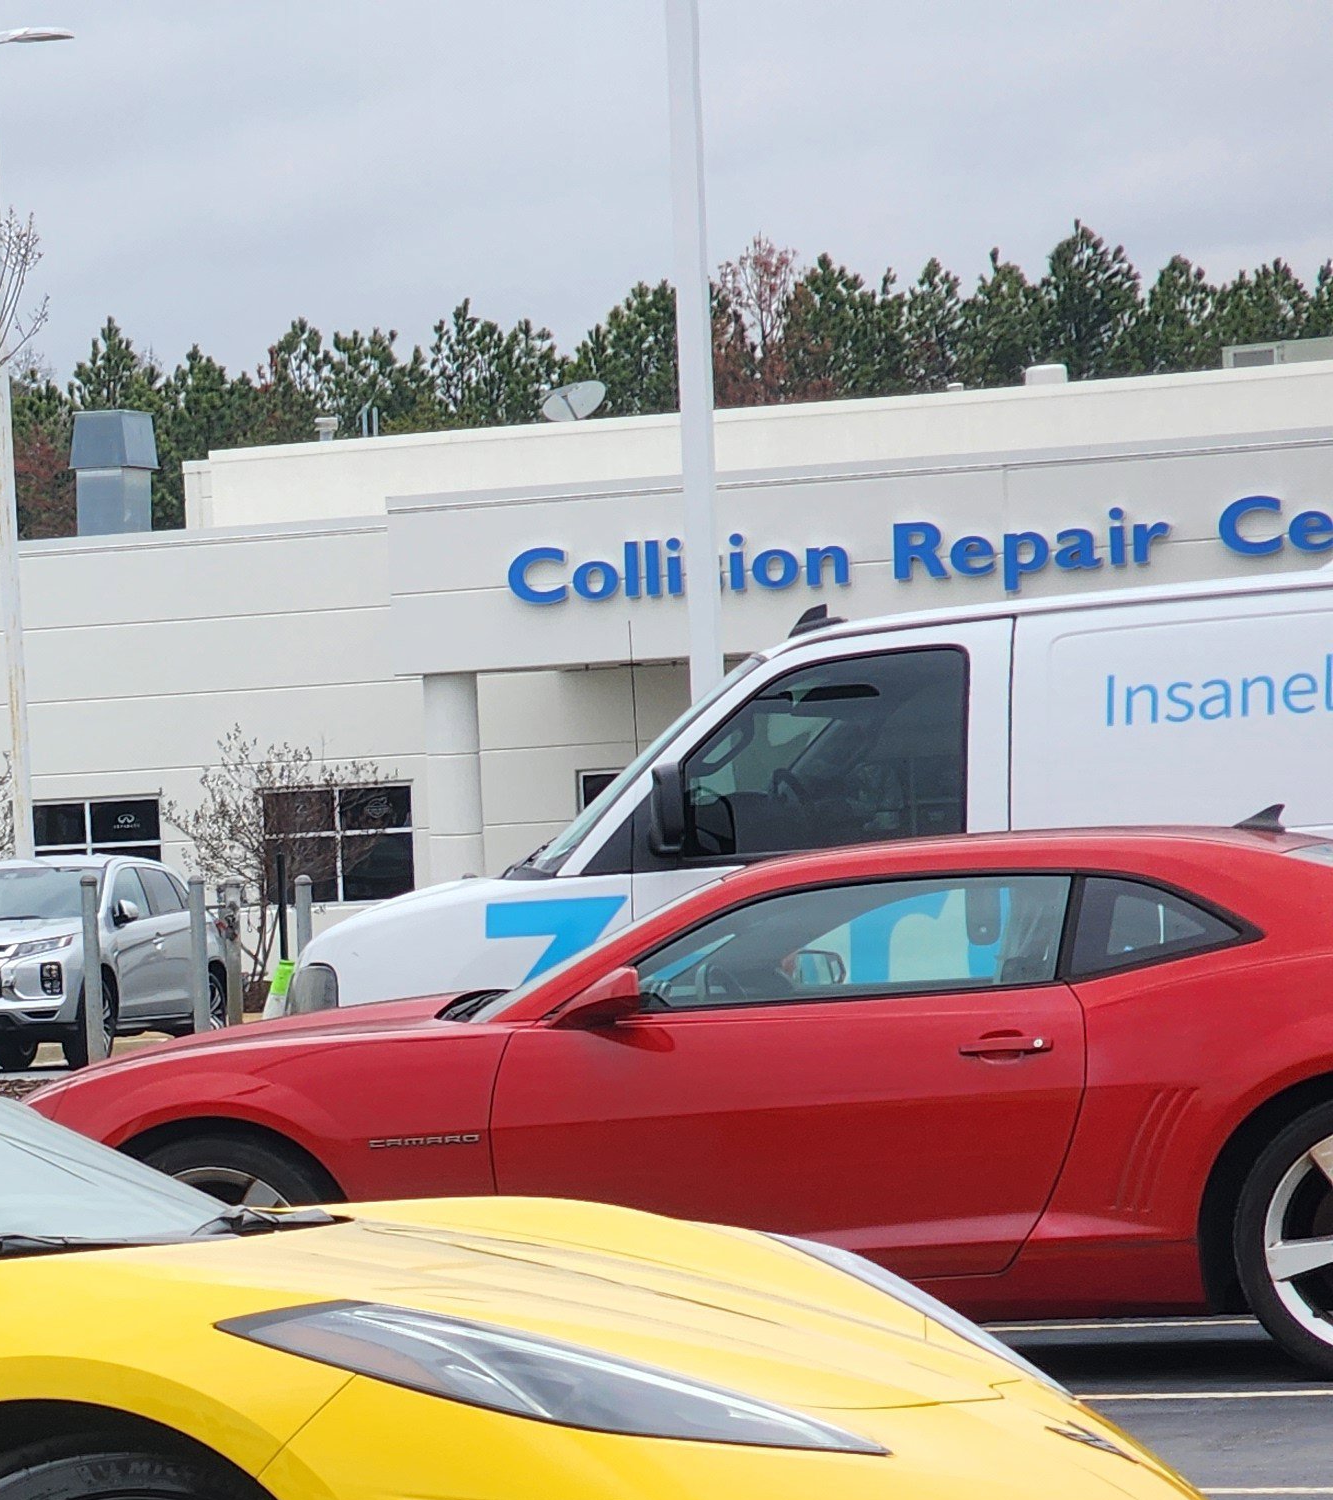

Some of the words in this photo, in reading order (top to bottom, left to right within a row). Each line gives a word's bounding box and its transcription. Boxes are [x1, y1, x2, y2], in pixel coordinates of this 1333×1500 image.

[507, 533, 851, 606] Colliion
[893, 507, 1171, 592] Repair
[1106, 653, 1333, 727] Insanel
[368, 1134, 480, 1149] CAMARO
